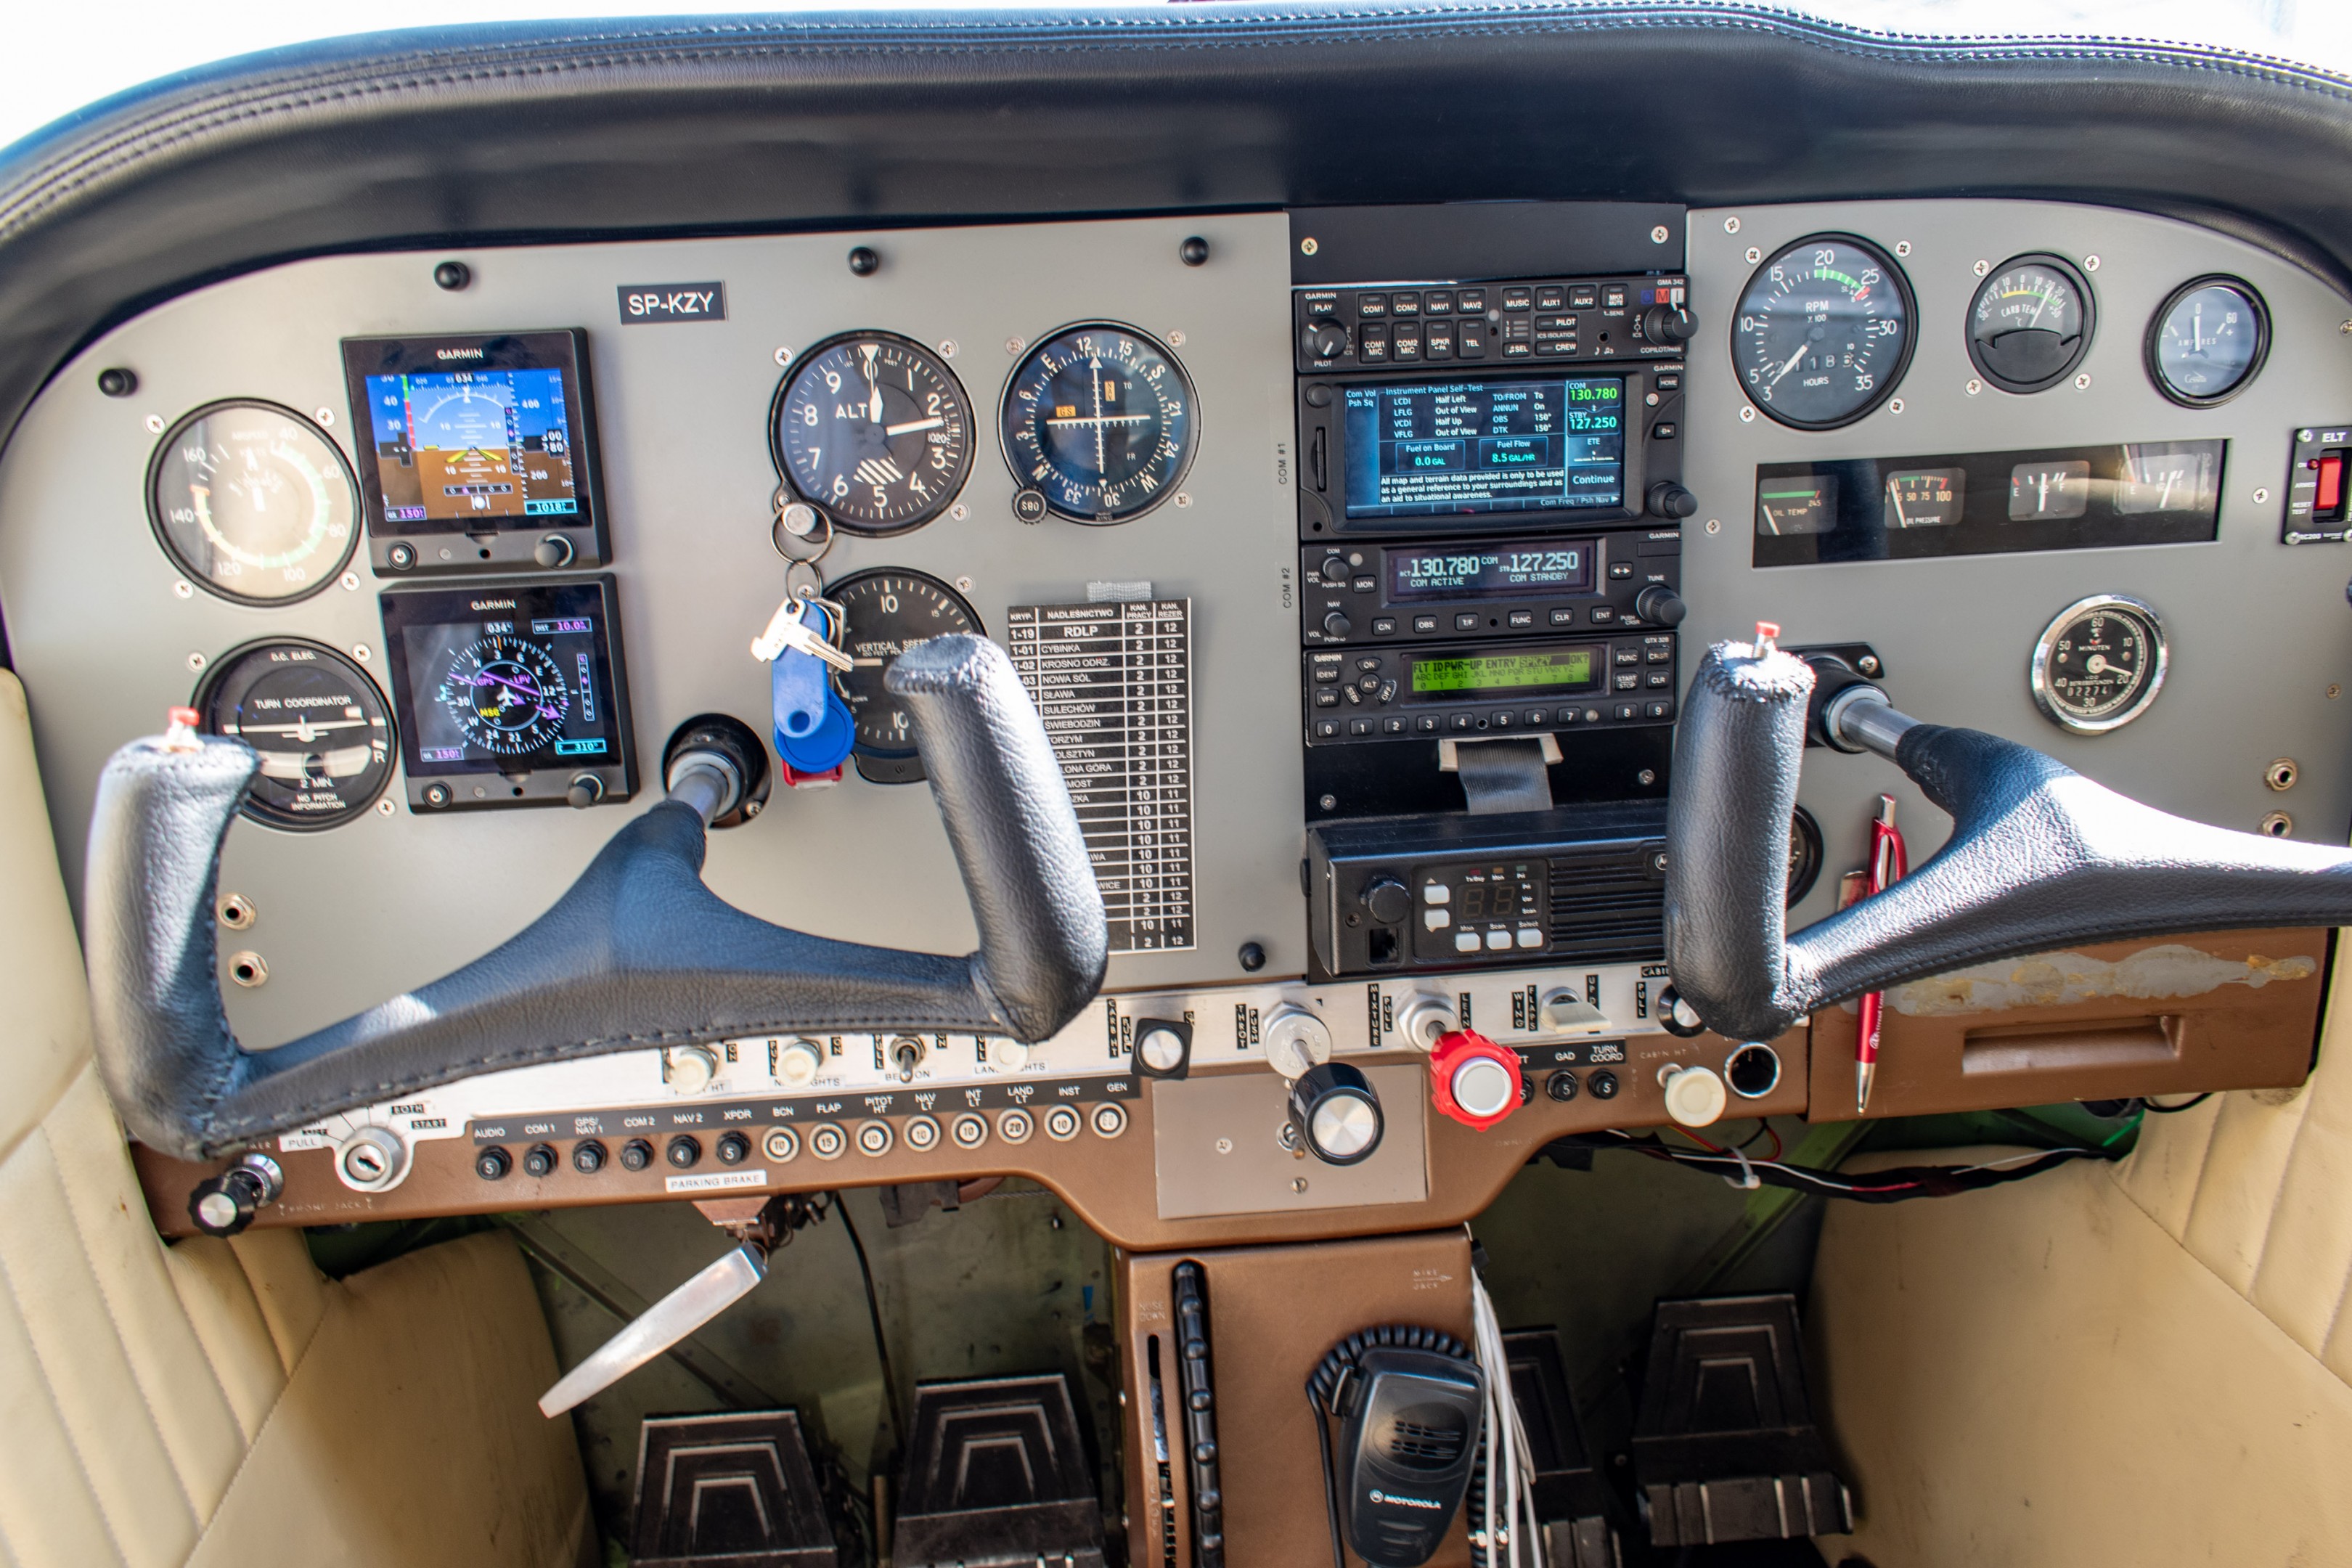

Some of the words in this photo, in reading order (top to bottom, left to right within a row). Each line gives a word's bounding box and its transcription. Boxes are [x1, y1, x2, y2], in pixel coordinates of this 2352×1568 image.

[1815, 250, 1834, 266] 20
[1771, 266, 1784, 282] 15
[1861, 269, 1879, 285] 25
[629, 290, 714, 316] SP-KZY
[1806, 301, 1829, 312] RPM
[1741, 317, 1754, 332] 10
[1879, 320, 1897, 335] 30
[1077, 337, 1093, 351] 12
[1119, 340, 1133, 356] 15
[436, 348, 483, 360] GARMIN
[826, 372, 841, 394] 9
[1803, 377, 1829, 386] HOURS
[1855, 375, 1873, 391] 35
[1450, 384, 1483, 393] Self-Test
[1570, 388, 1617, 400] 130.780
[383, 396, 398, 407] 40
[522, 399, 540, 409] 400
[927, 393, 941, 415] 2
[836, 403, 867, 419] ALT
[1168, 401, 1182, 417] 21
[804, 404, 818, 426] 8
[387, 420, 401, 430] 30
[1451, 417, 1462, 426] Up
[1569, 416, 1617, 430] 127.250
[928, 433, 947, 444] 1020
[2322, 432, 2346, 443] ELT
[184, 447, 206, 462] 160
[1164, 443, 1179, 459] 24
[1278, 444, 1286, 454] #1
[808, 447, 820, 470] 7
[931, 447, 945, 469] 3
[1416, 457, 1431, 466] 0.0
[322, 465, 340, 479] 60
[1278, 460, 1287, 484] COM
[910, 471, 926, 493] 4
[1573, 475, 1614, 483] Continue
[835, 474, 849, 496] 6
[873, 486, 887, 507] 5
[1906, 493, 1916, 502] 50
[1936, 490, 1952, 502] 100
[170, 510, 195, 523] 140
[1788, 508, 1808, 517] TEMP
[329, 524, 346, 537] 80
[1411, 556, 1479, 576] 130.780
[1510, 552, 1578, 572] 127.250
[218, 563, 241, 576] 120
[282, 568, 306, 581] 100
[1281, 568, 1290, 579] #2
[1432, 578, 1464, 587] ACTIVE
[1283, 584, 1291, 608] COM
[471, 600, 516, 611] GARMIN
[881, 595, 899, 613] 10
[1048, 608, 1113, 619] NADLEŚNICTWO
[2091, 618, 2104, 627] 60
[1011, 629, 1034, 640] 1-19
[1064, 625, 1098, 637] RDLP
[1135, 622, 1143, 634] 2
[1164, 622, 1177, 632] 12
[855, 641, 897, 653] VERTICAL
[2059, 641, 2070, 650] 50
[2123, 637, 2133, 647] 10
[1013, 645, 1034, 656] 1-01
[1041, 644, 1080, 653] CYBINKA
[1042, 658, 1080, 669] KROSNO
[1042, 675, 1071, 684] NOWA
[1073, 673, 1091, 683] SÓL
[1043, 690, 1075, 699] SŁAWA
[254, 699, 281, 709] TURN
[285, 695, 351, 707] COORDINATOR
[457, 697, 470, 706] 30
[480, 707, 501, 716] MSG
[1044, 703, 1095, 714] SULECHÓW
[1045, 718, 1101, 730] ŚWIEBODZIN
[373, 751, 385, 762] R
[1086, 763, 1112, 772] GÓRA
[312, 777, 334, 788] MIN.
[315, 793, 337, 801] PITCH
[291, 801, 346, 811] INFORMATION
[1593, 1045, 1617, 1053] TURN
[1555, 1051, 1575, 1061] GAD
[1591, 1053, 1624, 1062] COORD
[1008, 1087, 1034, 1096] LAND
[1058, 1087, 1080, 1096] INST
[1106, 1082, 1127, 1092] GEN
[773, 1107, 793, 1116] BCN
[817, 1103, 841, 1113] FLAP
[673, 1114, 695, 1124] NAV
[724, 1109, 752, 1120] XPDR
[474, 1127, 505, 1138] AUDIO
[289, 1136, 318, 1147] PULL
[671, 1177, 722, 1191] PARKING
[726, 1175, 760, 1186] BRAKE
[1384, 1494, 1442, 1510] MOTOROLA
